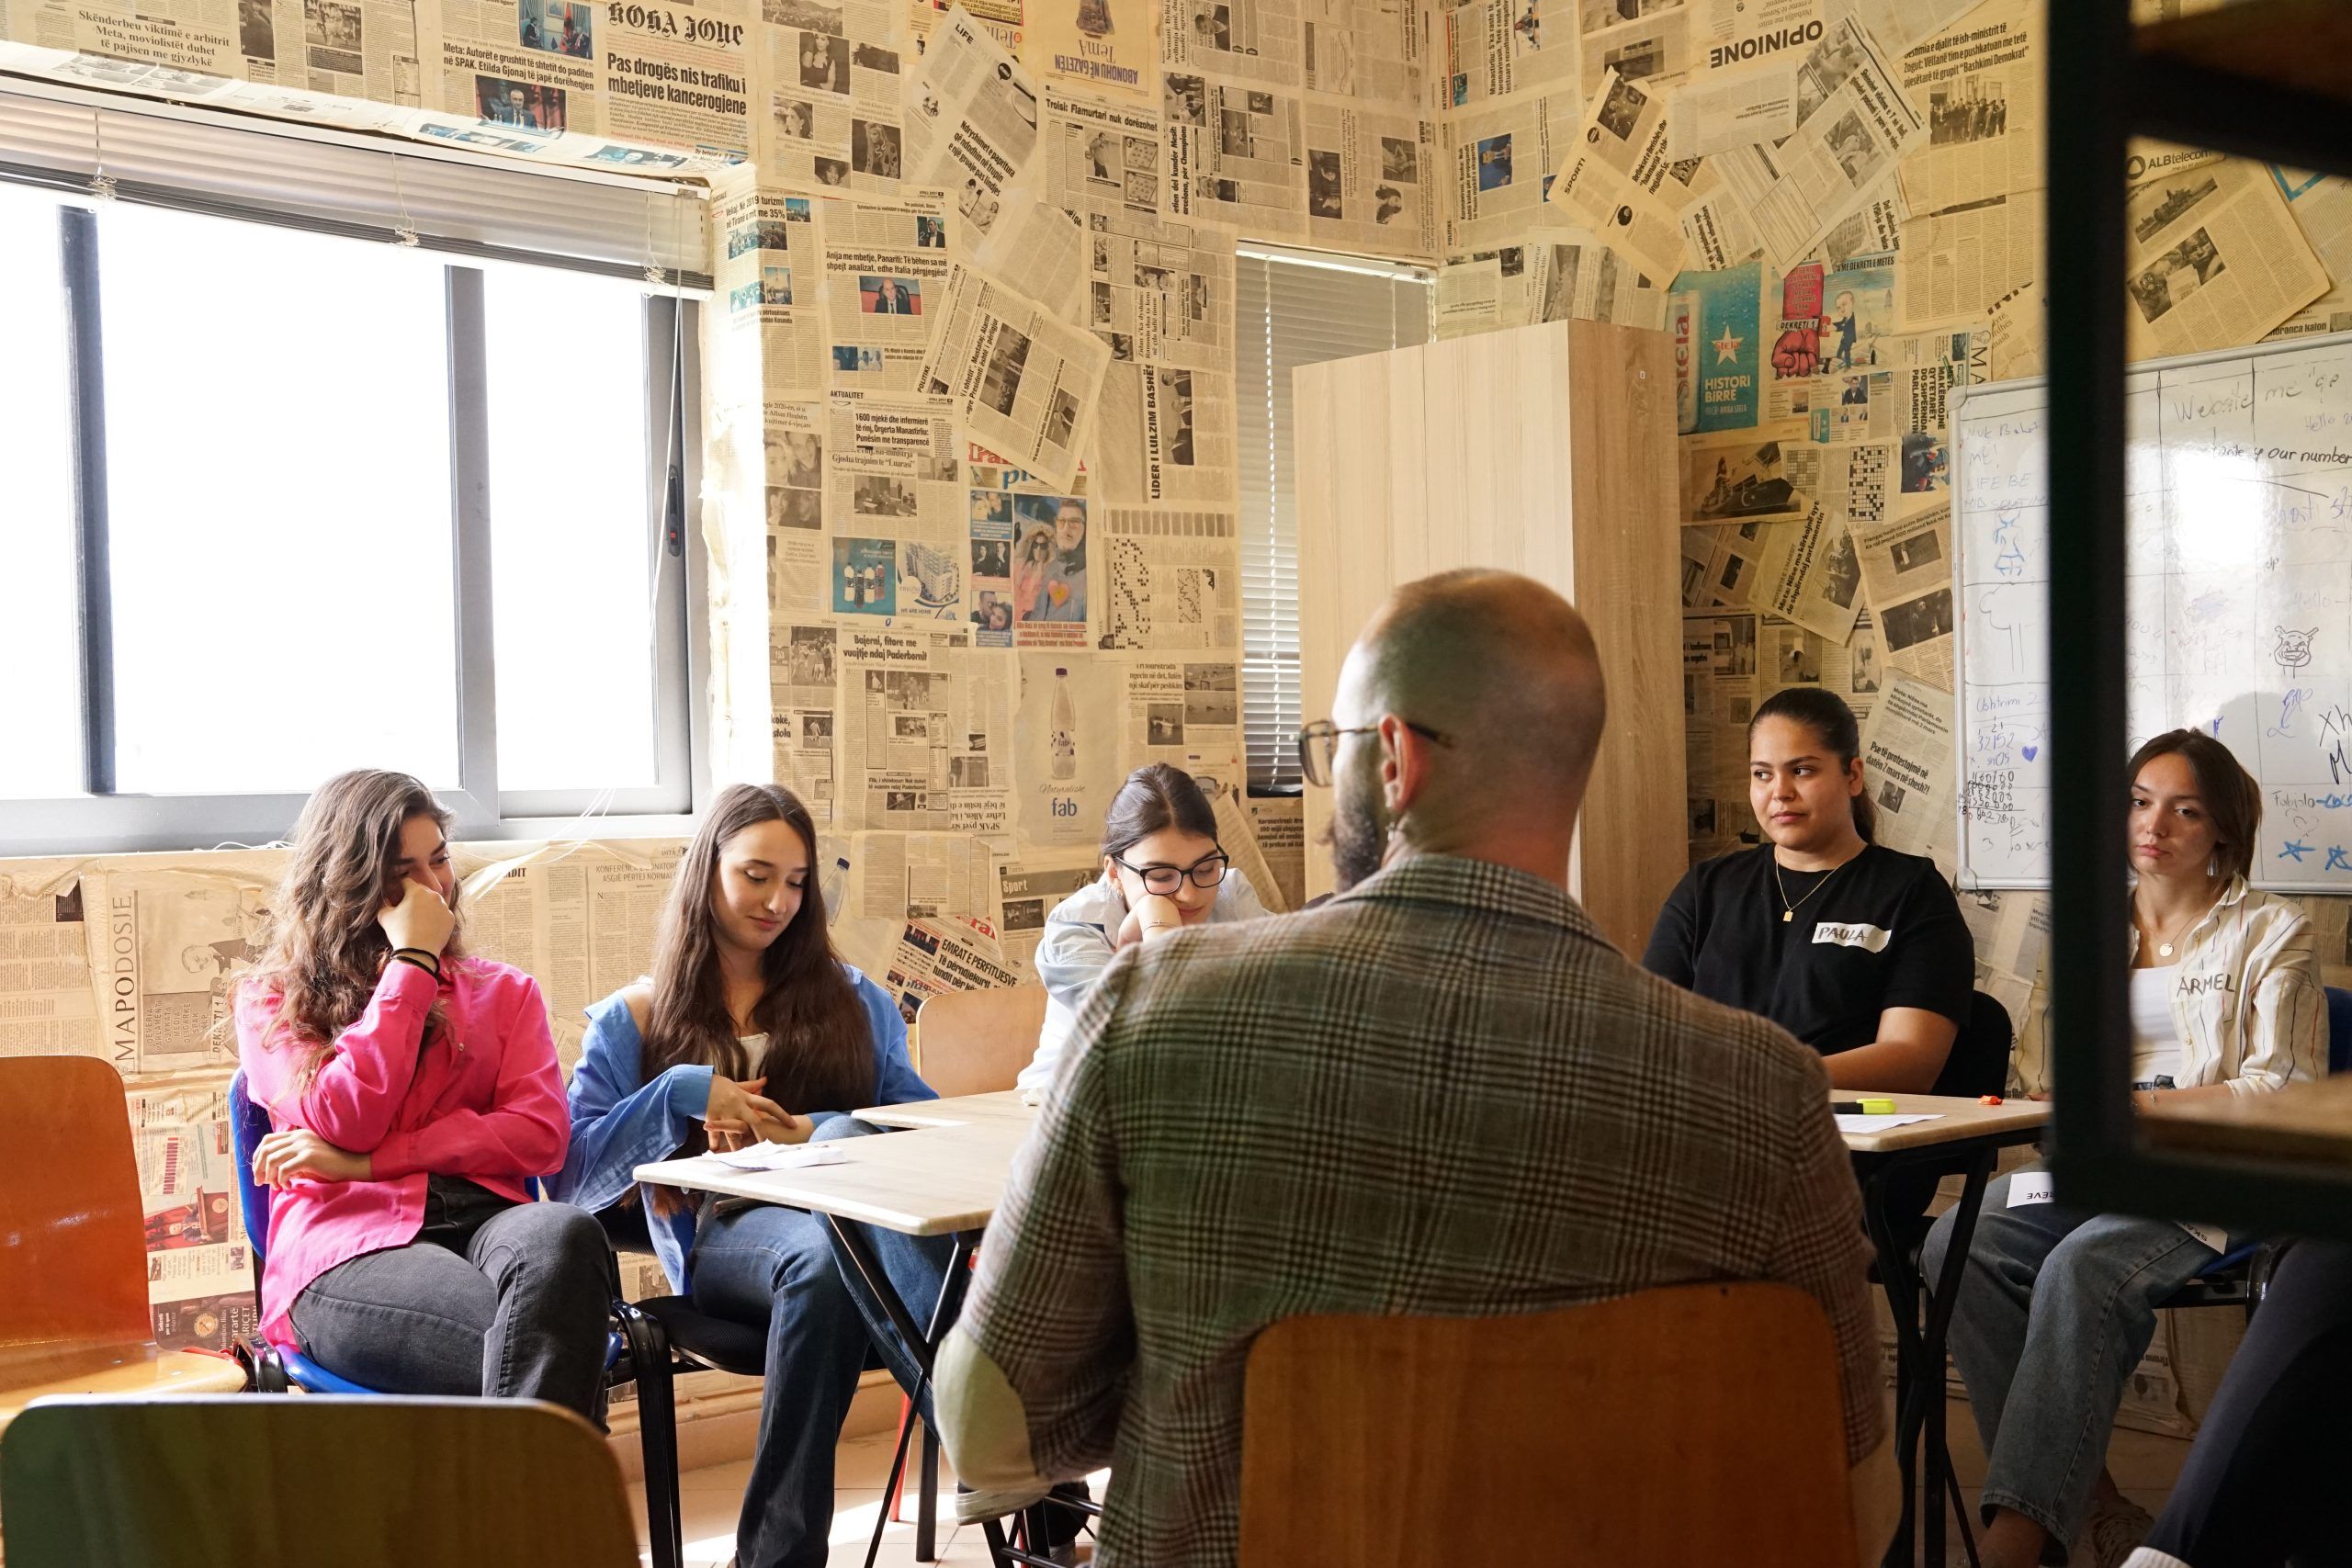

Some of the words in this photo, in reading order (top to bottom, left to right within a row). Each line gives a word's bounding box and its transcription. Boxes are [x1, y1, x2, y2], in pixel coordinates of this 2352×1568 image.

[79, 10, 141, 30] Skënderbeu
[145, 24, 183, 38] viktimë
[194, 33, 230, 47] arbitrit
[956, 23, 974, 44] LIFE
[96, 26, 126, 39] Meta,
[129, 33, 184, 50] moviolistët
[187, 43, 215, 55] duhet
[1079, 39, 1115, 63] TemA
[1711, 20, 1823, 69] OPINIONE
[1904, 61, 1924, 73] Zogut:
[1924, 54, 1948, 68] Vëllanë
[1948, 51, 1959, 62] tim
[1964, 39, 2002, 59] pushkatuan
[2003, 38, 2013, 47] me
[2014, 31, 2027, 45] tetë
[101, 39, 110, 48] të
[113, 41, 149, 55] pajisen
[171, 52, 212, 66] gjyzlykë
[443, 42, 465, 54] Meta:
[467, 47, 492, 60] Autorët
[500, 53, 526, 65] grushtit
[536, 60, 557, 71] shtetit
[558, 64, 567, 73] do
[568, 66, 594, 79] paditen
[1055, 54, 1089, 74] GAZETËN
[444, 55, 453, 64] në
[455, 57, 477, 69] SPAK.
[479, 62, 501, 73] Etilda
[502, 64, 526, 80] Gjonaj
[537, 72, 552, 83] japë
[553, 74, 594, 91] dorëheqjen
[607, 51, 631, 73] Pas
[634, 57, 678, 81] drogës
[680, 67, 699, 85] nis
[701, 70, 740, 93] trafiku
[741, 77, 746, 95] i
[1090, 61, 1100, 79] NË
[1101, 63, 1138, 85] ABONOHU
[1904, 72, 1932, 89] pjesëtarë
[1932, 70, 1939, 81] të
[1939, 64, 1959, 80] grupit
[608, 76, 664, 100] mbetjeve
[667, 85, 747, 115] kancerogjene
[1046, 98, 1068, 112] Troisi:
[1070, 104, 1107, 120] Flamurtari
[1109, 114, 1122, 124] nuk
[2148, 150, 2211, 169] ALBtelecom
[1564, 157, 1586, 195] SPORTI
[827, 251, 842, 261] Anija
[854, 253, 876, 263] mbetje,
[877, 254, 902, 264] Panariti:
[903, 255, 910, 264] Të
[911, 257, 929, 265] bëhen
[827, 262, 846, 271] shpejt
[848, 264, 876, 272] analizat,
[877, 265, 892, 273] edhe
[895, 265, 910, 274] Italia
[1781, 321, 1809, 330] DEKRETI
[917, 366, 930, 393] POLITIKE
[1705, 375, 1750, 390] HISTORI
[1921, 368, 1928, 381] DO
[1938, 367, 1945, 381] MA
[831, 390, 864, 399] AKTUALITET
[1705, 389, 1736, 403] BIRRE
[1928, 367, 1937, 423] QYTETARËT,
[1938, 383, 1946, 430] KËRKOJNË
[855, 413, 870, 422] 1600
[871, 414, 888, 423] mjekë
[900, 416, 928, 425] infermierë
[855, 423, 862, 432] të
[863, 424, 874, 434] rinj,
[874, 424, 896, 434] Orgerta
[896, 426, 929, 435] Manastirliu:
[856, 434, 881, 443] Punësim
[891, 437, 930, 446] transparencë
[1148, 411, 1159, 455] LULZIM
[1151, 464, 1160, 499] LIDER
[1811, 500, 1819, 516] qyt
[1798, 515, 1814, 552] kërkojnë
[1786, 604, 1794, 615] do
[1791, 561, 1809, 604] shpërndaj
[1805, 513, 1825, 563] parlamentin
[1794, 553, 1803, 567] ma
[1787, 566, 1798, 587] Nëse
[1778, 587, 1791, 611] Meta:
[854, 635, 882, 647] Bajerni,
[884, 636, 904, 646] fitore
[843, 648, 868, 660] vuajtje
[870, 649, 885, 660] ndaj
[887, 649, 927, 660] Paderbornit
[1871, 741, 1881, 753] Pse
[1881, 748, 1888, 757] të
[1886, 752, 1921, 775] protestojmë
[1920, 769, 1928, 779] në
[1866, 754, 1883, 771] datën
[1882, 762, 1888, 773] 2
[1885, 764, 1901, 780] mars
[1901, 773, 1908, 784] në
[1907, 778, 1930, 795] shesh?!
[1051, 797, 1077, 817] fab
[963, 820, 978, 829] pyet
[979, 822, 1000, 830] SPAK
[1002, 880, 1028, 895] Sport
[1818, 927, 1867, 942] PAULA
[942, 939, 968, 961] EMRAT
[966, 953, 972, 964] E
[971, 955, 1017, 987] PERFITUESVE
[2177, 974, 2234, 998] ARMEL
[173, 1010, 181, 1037] MEDIA
